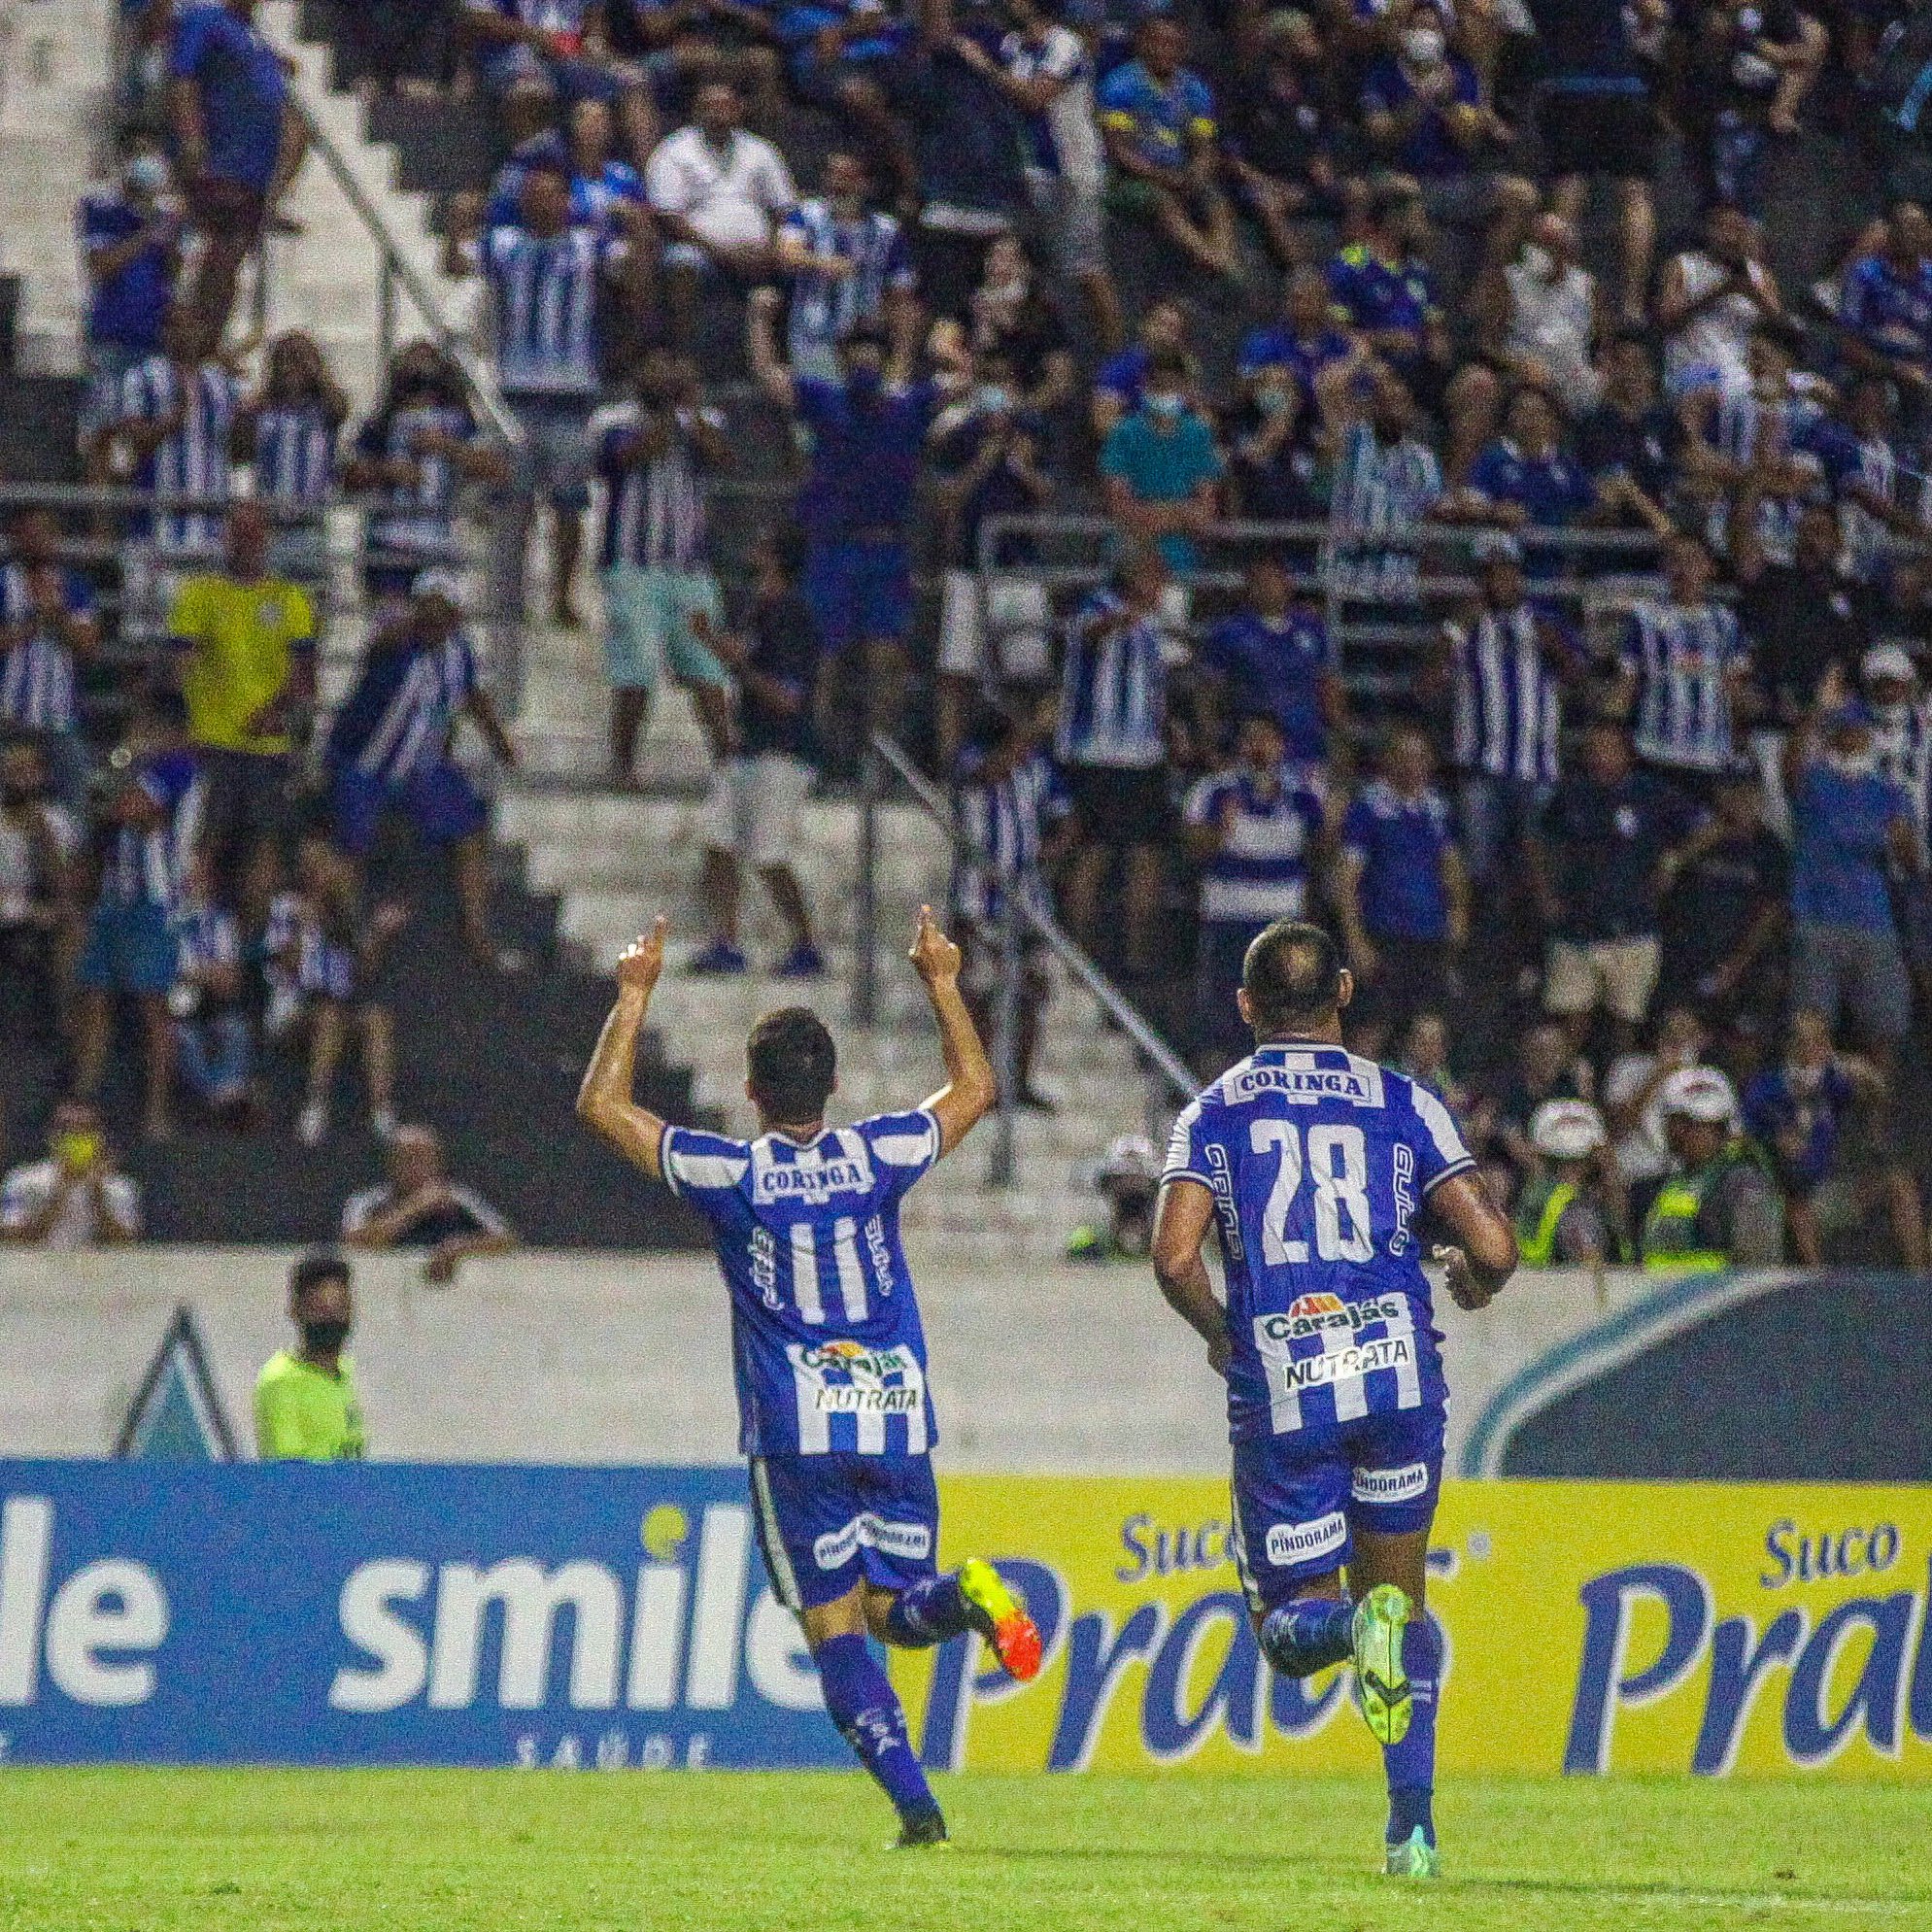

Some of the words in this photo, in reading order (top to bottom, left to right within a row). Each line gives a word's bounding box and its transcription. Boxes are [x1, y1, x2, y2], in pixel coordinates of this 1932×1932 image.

[1239, 1069, 1365, 1097] CORINGA
[1250, 1119, 1373, 1267] 28
[791, 1217, 869, 1324] 11
[1265, 1297, 1400, 1340] Carajás
[1285, 1339, 1408, 1389] NUTRATA
[815, 1388, 916, 1411] NUTRATA
[1356, 1468, 1424, 1493] INDORAMA
[1115, 1513, 1237, 1583] Suc
[1271, 1517, 1345, 1554] PINDORAMA
[1759, 1517, 1901, 1590] Suco
[328, 1504, 824, 1712] smile
[1562, 1559, 1932, 1779] Pra
